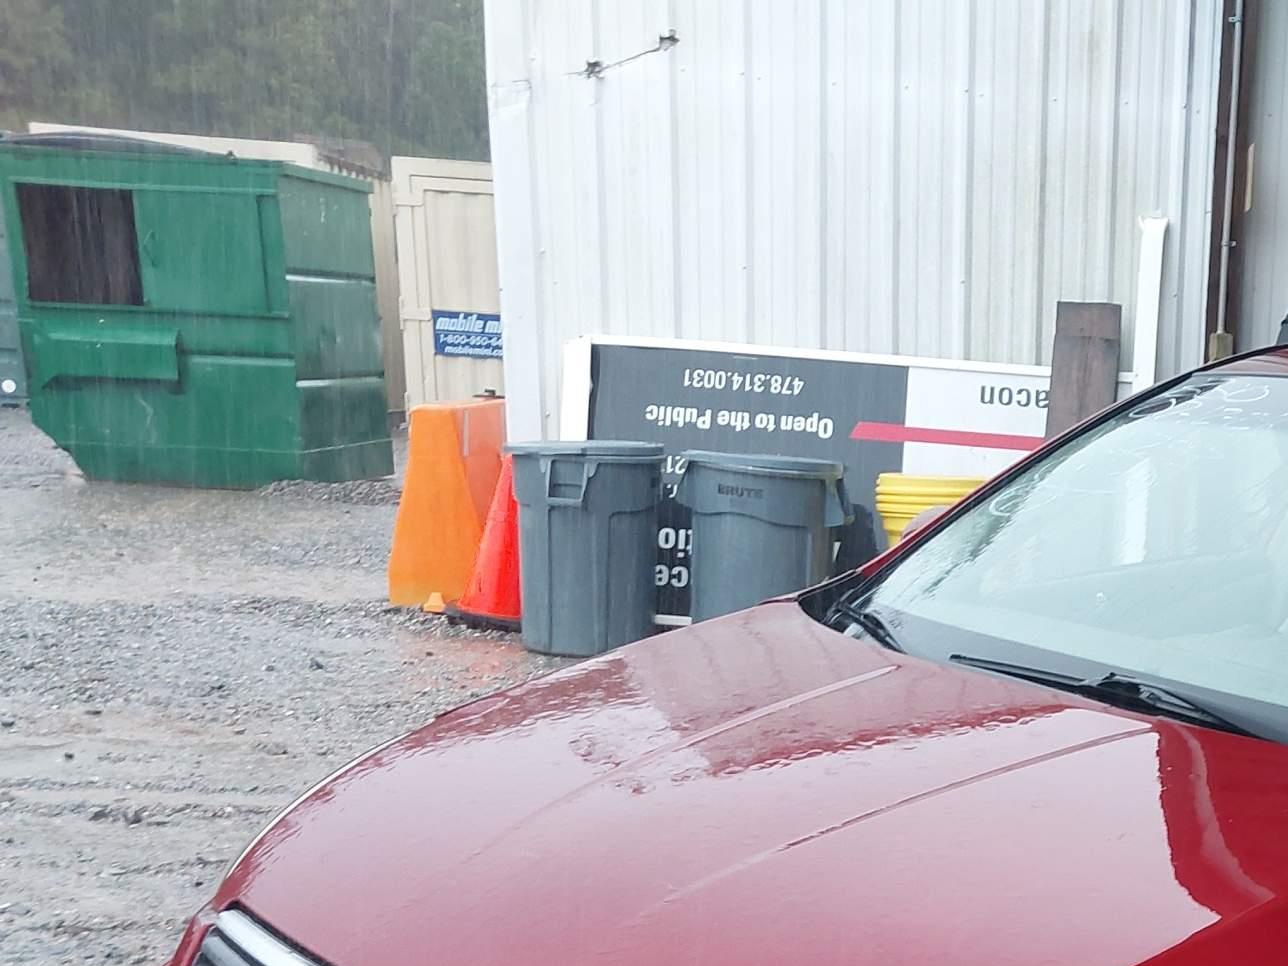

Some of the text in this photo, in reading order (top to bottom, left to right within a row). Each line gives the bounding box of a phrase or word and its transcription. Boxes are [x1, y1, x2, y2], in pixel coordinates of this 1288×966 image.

[435, 313, 485, 332] mobile
[683, 368, 804, 395] 478.314.0031
[644, 405, 834, 439] Open to the Public
